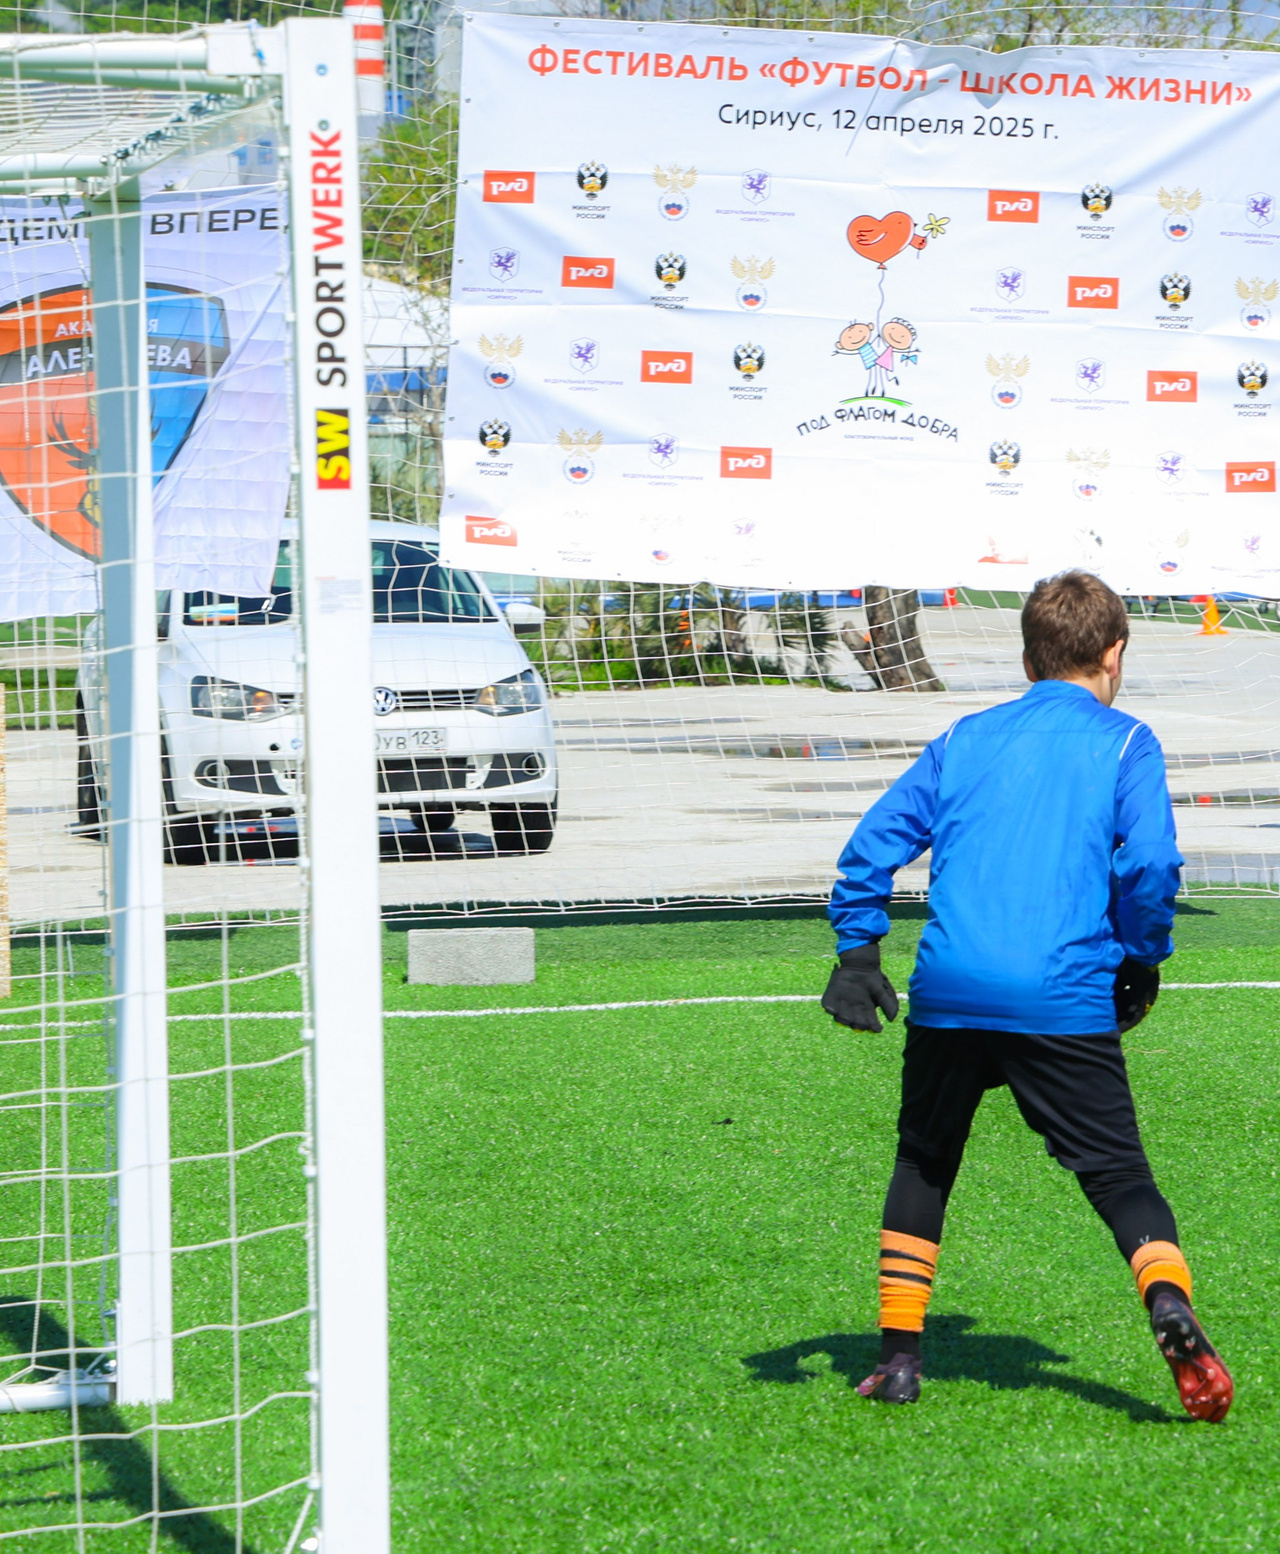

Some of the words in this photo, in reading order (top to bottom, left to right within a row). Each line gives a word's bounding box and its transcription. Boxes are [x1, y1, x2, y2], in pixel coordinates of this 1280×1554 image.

[528, 43, 749, 82] ФЕСТИВАЛЬ
[758, 56, 928, 92] «ФУТБОЛ
[960, 70, 1096, 99] ШКОЛА
[1105, 75, 1253, 106] ЖИЗНИ»
[718, 103, 823, 132] Сириус,
[832, 109, 857, 130] 12
[866, 114, 964, 137] апреля
[973, 115, 1034, 138] 2025
[1043, 122, 1059, 140] г.
[309, 130, 347, 388] SPORTWERK
[316, 409, 351, 482] SW
[796, 415, 831, 436] ПОД
[834, 405, 896, 423] ФЛАГОМ
[901, 412, 958, 442] ДОБРА
[411, 730, 440, 746] 123
